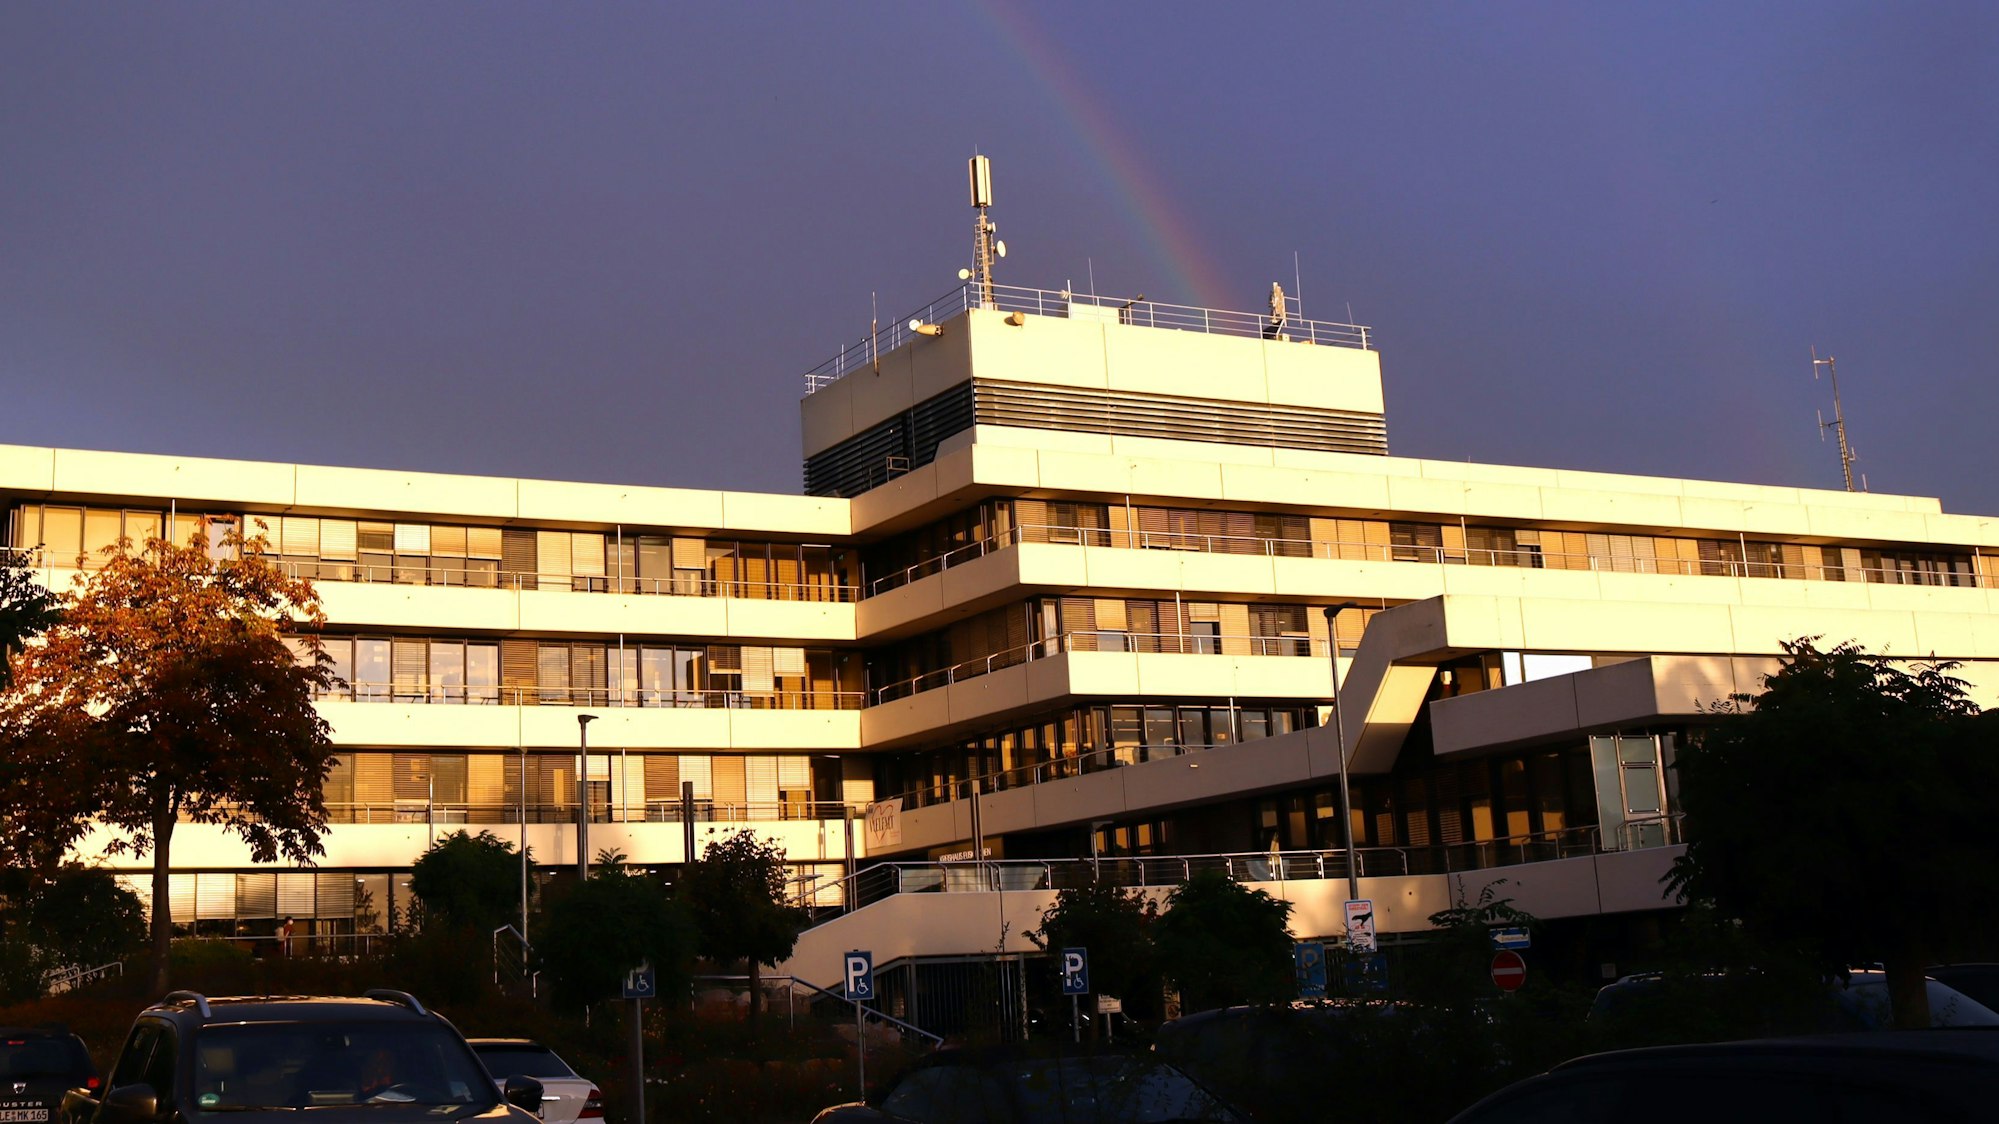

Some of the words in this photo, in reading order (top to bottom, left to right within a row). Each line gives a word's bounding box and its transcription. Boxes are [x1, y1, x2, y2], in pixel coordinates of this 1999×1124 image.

[847, 956, 869, 993] P
[1065, 953, 1084, 987] P
[31, 1110, 47, 1120] 165
